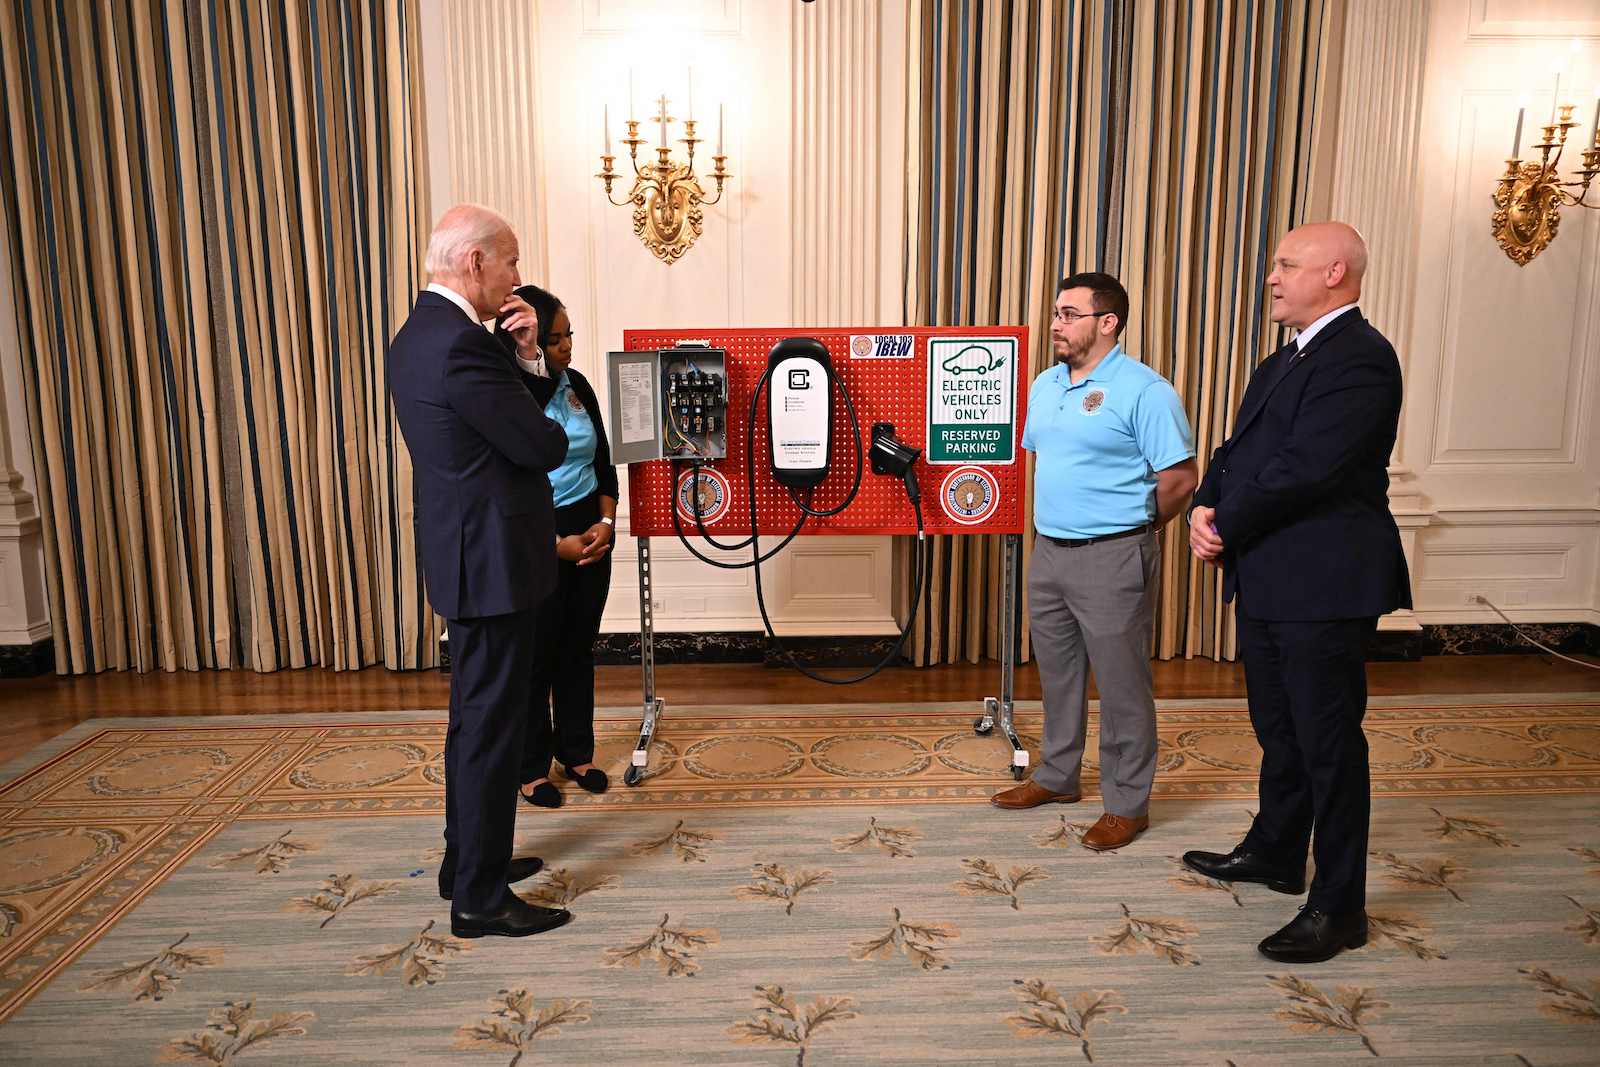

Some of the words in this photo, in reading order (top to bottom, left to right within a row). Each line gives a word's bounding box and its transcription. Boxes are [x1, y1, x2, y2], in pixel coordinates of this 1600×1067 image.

[875, 335, 897, 344] LOCAL
[899, 335, 913, 344] 103
[875, 341, 913, 357] IBEW
[942, 379, 1001, 391] ELECTRIC
[942, 394, 1002, 406] VEHICLES
[955, 408, 988, 420] ONLY
[941, 430, 1001, 441] RESERVED
[946, 443, 997, 454] PARKING
